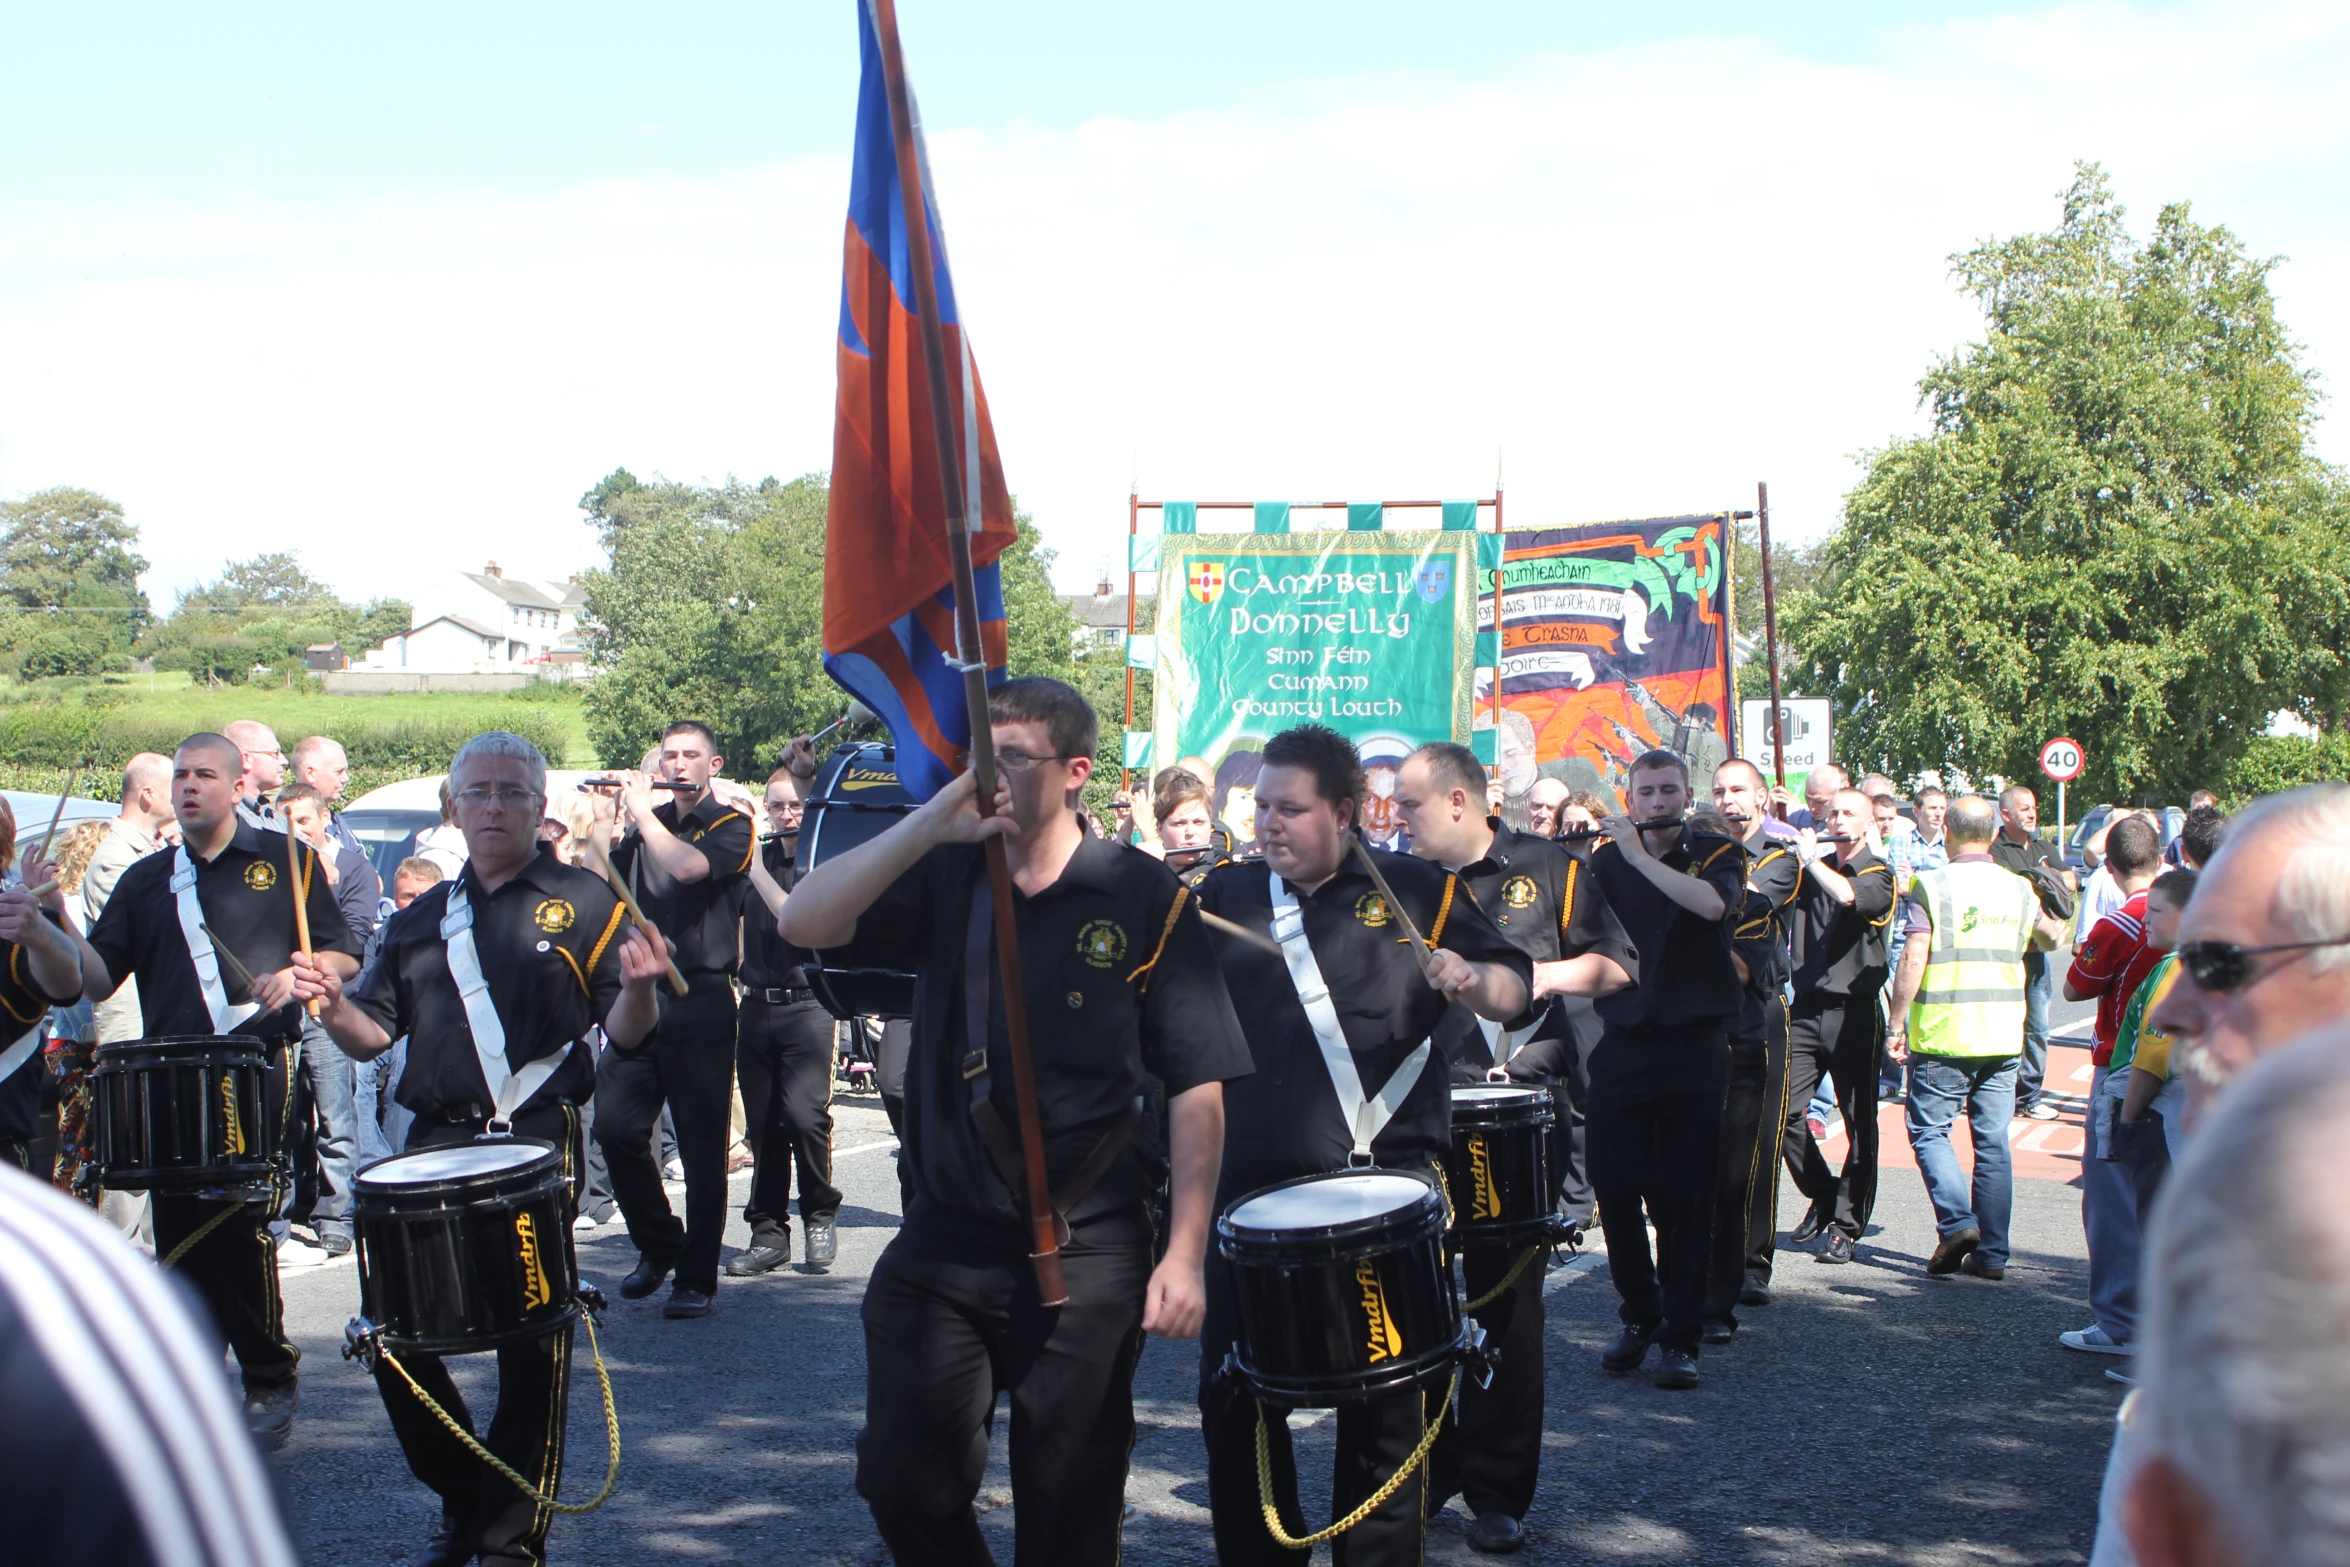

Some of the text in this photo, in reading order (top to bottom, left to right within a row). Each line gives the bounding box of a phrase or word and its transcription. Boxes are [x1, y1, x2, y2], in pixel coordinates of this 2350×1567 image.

[1599, 597, 1621, 614] 1981
[1266, 645, 1372, 666] Sinn Féin
[1267, 673, 1369, 692] Cumann
[1232, 696, 1402, 720] County Louth
[1760, 752, 1814, 767] Seed
[2047, 751, 2077, 767] 40
